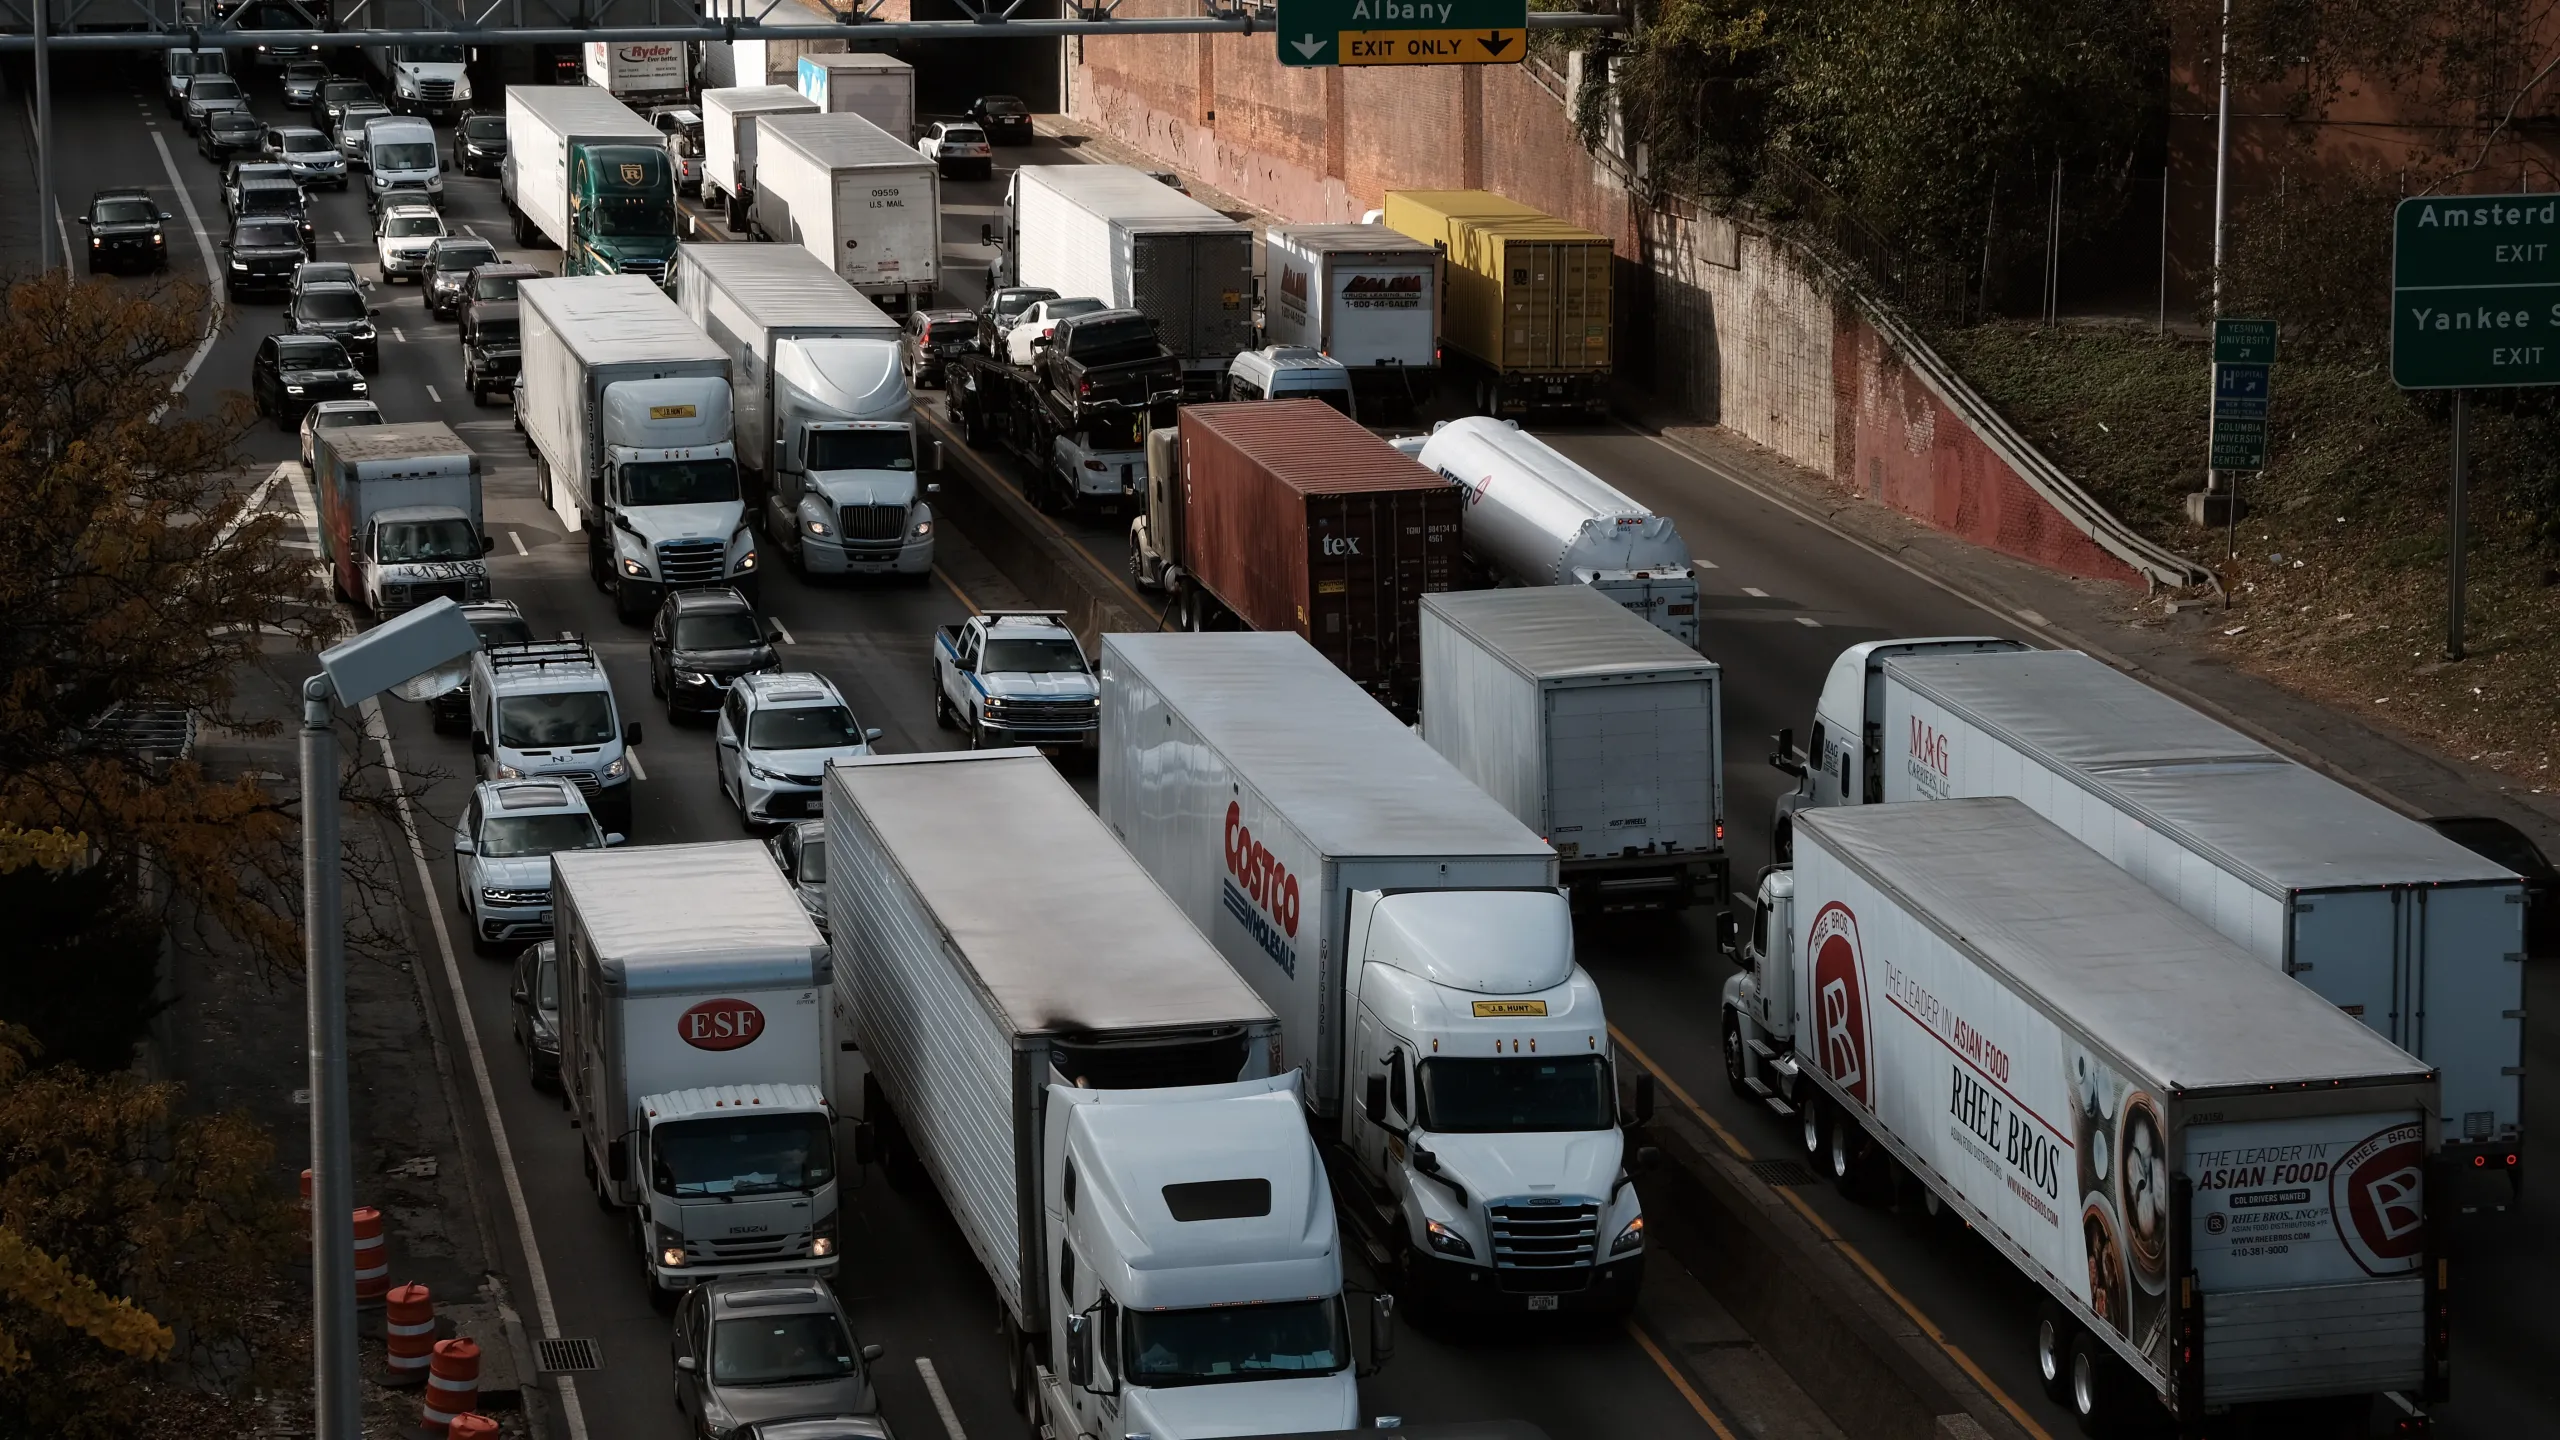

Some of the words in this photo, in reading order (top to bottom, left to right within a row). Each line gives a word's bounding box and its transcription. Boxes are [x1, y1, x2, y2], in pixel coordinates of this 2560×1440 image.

[1352, 0, 1452, 24] Albany
[631, 45, 673, 59] Ryder
[1351, 40, 1395, 56] EXIT
[1407, 39, 1462, 55] ONLY
[625, 170, 641, 179] R
[871, 188, 899, 197] 09559
[2417, 201, 2555, 228] Amsterd
[2495, 244, 2548, 262] EXIT
[1344, 275, 1421, 292] SALEM
[1345, 300, 1418, 308] 1-800-44-SALEM
[2411, 306, 2530, 331] Yankee
[2228, 324, 2265, 333] YESHIVA
[2220, 335, 2271, 345] UNIVERSITY
[2492, 347, 2545, 365] EXIT
[2218, 422, 2261, 432] COLUMBIA
[2214, 433, 2263, 444] UNIVERSITY
[2213, 444, 2250, 454] MEDICAL
[2213, 455, 2246, 465] CENTER
[1322, 532, 1361, 556] tex
[1825, 738, 1839, 758] MAG
[1909, 715, 1949, 778] MAG
[1907, 759, 1938, 796] CARRIERS,
[1624, 818, 1647, 826] WHEELS
[1225, 800, 1300, 938] COSTCO
[1244, 899, 1297, 982] WHOLESALE
[1320, 938, 1328, 1036] CW1751020
[688, 1010, 756, 1040] ESF
[1884, 959, 1902, 998] THE
[1904, 975, 1940, 1028] LEADER
[1941, 1005, 1952, 1038] IN
[1953, 1016, 1983, 1063] ASIAN
[1984, 1039, 2009, 1084] FOOD
[1950, 1064, 2002, 1153] RHEE
[2005, 1109, 2060, 1200] BROS
[1950, 1125, 1963, 1149] ASIAN
[1963, 1136, 1973, 1156] FOOD
[1973, 1143, 2003, 1181] DISTRIBUTORS
[2198, 1150, 2230, 1168] THE
[2236, 1145, 2303, 1165] LEADER
[2307, 1143, 2328, 1158] IN
[2346, 1141, 2380, 1170] RHEE
[2197, 1166, 2267, 1191] ASIAN
[2272, 1162, 2328, 1185] FOOD
[2006, 1173, 2059, 1229] WWW.RHEEBROS.COM
[2249, 1193, 2278, 1203] DRIVERS
[2279, 1191, 2307, 1201] WANTED
[2231, 1213, 2260, 1224] RHEE
[2231, 1225, 2252, 1233] ASIAN
[2270, 1221, 2316, 1230] DISTRIBUTORS
[729, 1225, 768, 1234] ISUZU
[2231, 1232, 2311, 1245] WWW.RHEEBROS.COM
[2231, 1245, 2289, 1257] 410-381-9000
